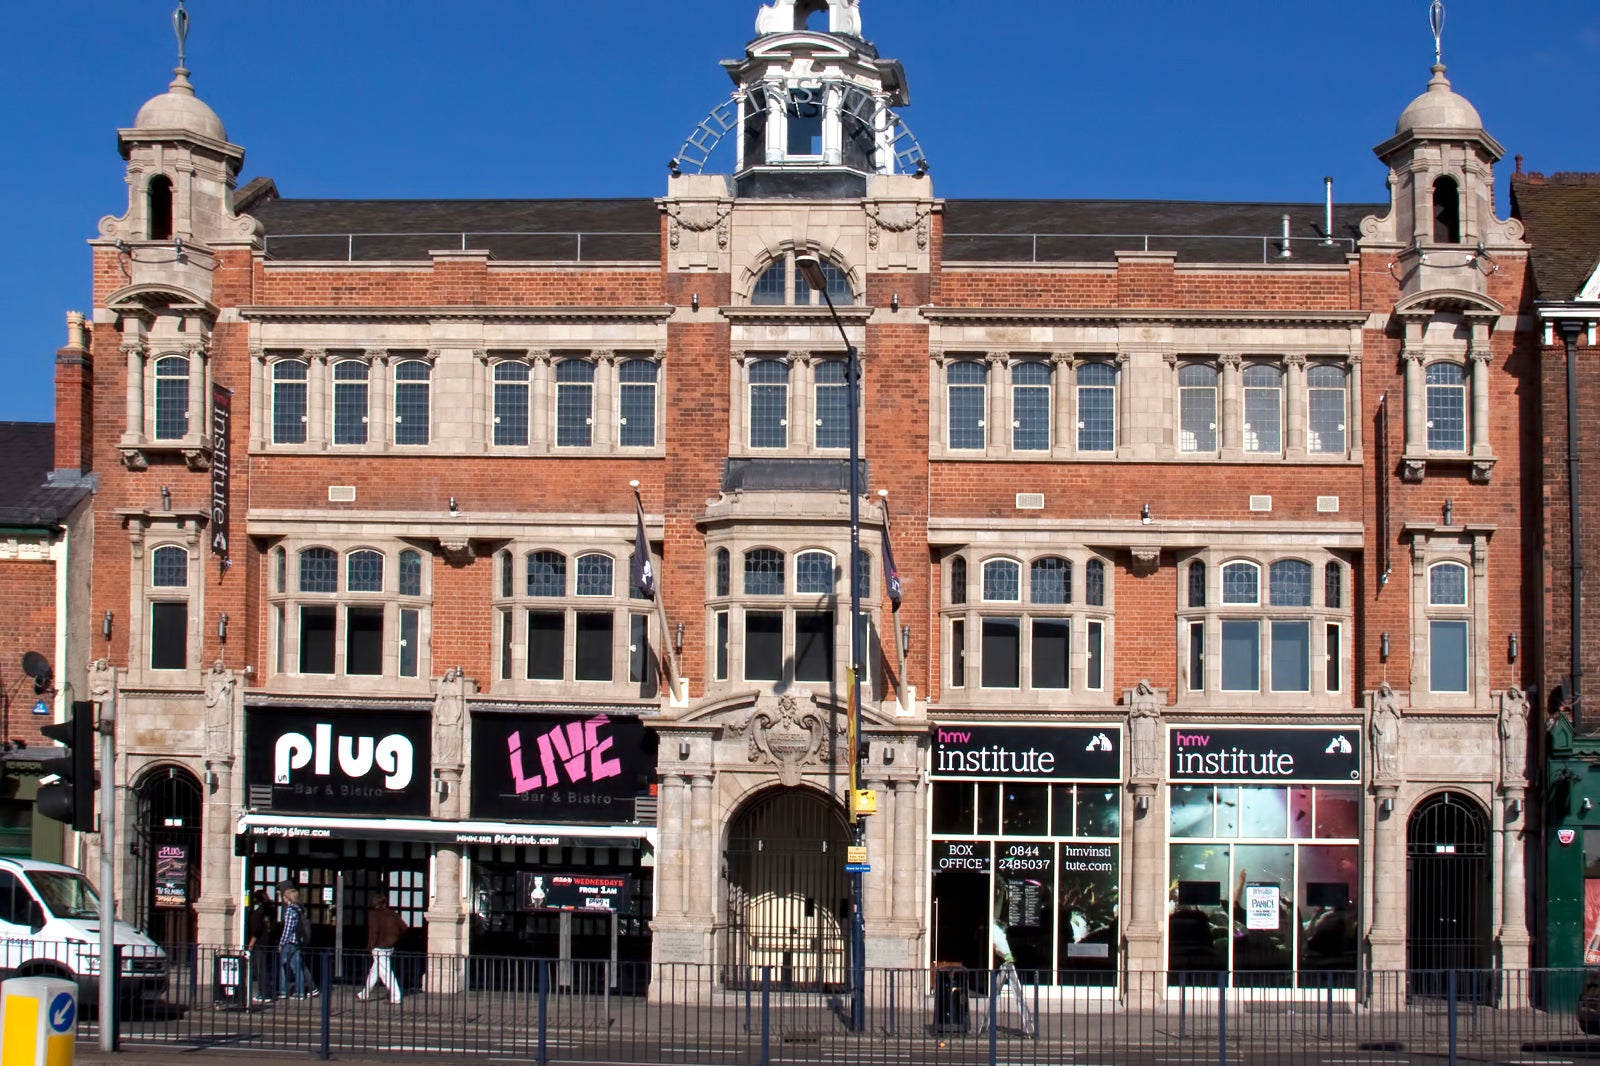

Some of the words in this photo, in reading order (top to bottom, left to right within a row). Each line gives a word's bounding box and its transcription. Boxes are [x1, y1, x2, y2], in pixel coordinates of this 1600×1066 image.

[677, 103, 738, 168] THE
[746, 79, 925, 172] INSTITUTE
[213, 406, 229, 525] institute
[938, 728, 971, 743] hmv
[1176, 731, 1210, 747] hmv
[274, 723, 413, 790] plug
[507, 713, 622, 794] LIVE
[937, 744, 1055, 773] institute
[1176, 747, 1294, 775] institute
[295, 784, 317, 795] Bar
[325, 784, 334, 795] &
[341, 785, 383, 797] Bistro
[551, 792, 561, 802] &
[568, 793, 612, 805] Bistro
[949, 845, 974, 855] BOX
[1009, 846, 1039, 856] 0844
[1065, 845, 1111, 857] hmvinsti
[939, 858, 983, 869] OFFICE
[998, 859, 1051, 870] 2485037
[1065, 861, 1112, 871] tute.com
[579, 886, 599, 894] FROM
